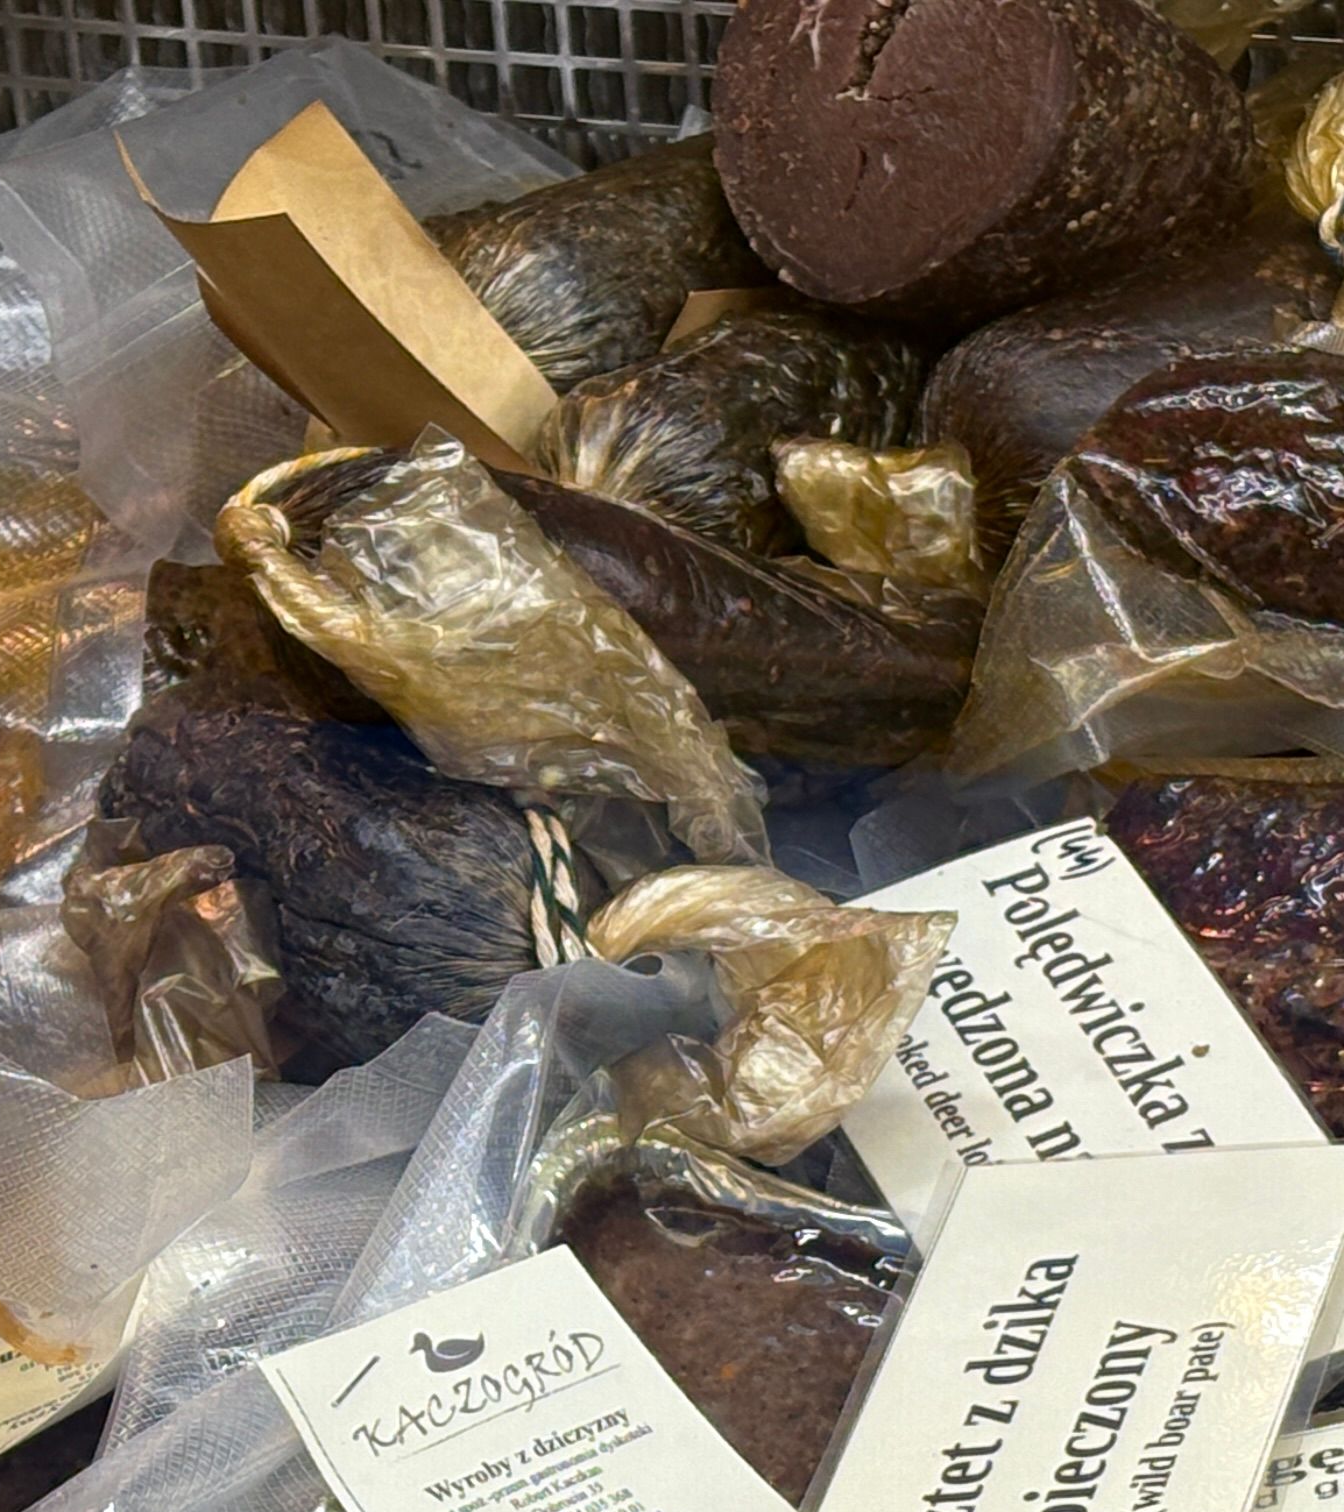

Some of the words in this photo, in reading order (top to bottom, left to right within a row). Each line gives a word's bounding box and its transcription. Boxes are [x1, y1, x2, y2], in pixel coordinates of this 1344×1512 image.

[982, 863, 1188, 1129] Polędwiczka
[924, 1092, 974, 1140] deer
[957, 1138, 1004, 1167] lo
[964, 1255, 1078, 1385] dzika
[352, 1329, 605, 1457] KACZOGRÓD
[964, 1401, 1018, 1426] z
[1146, 1391, 1200, 1448] boar
[1182, 1322, 1234, 1383] pate)
[423, 1457, 513, 1503] Wyroby
[514, 1449, 532, 1465] z
[532, 1408, 630, 1458] dziczyzny
